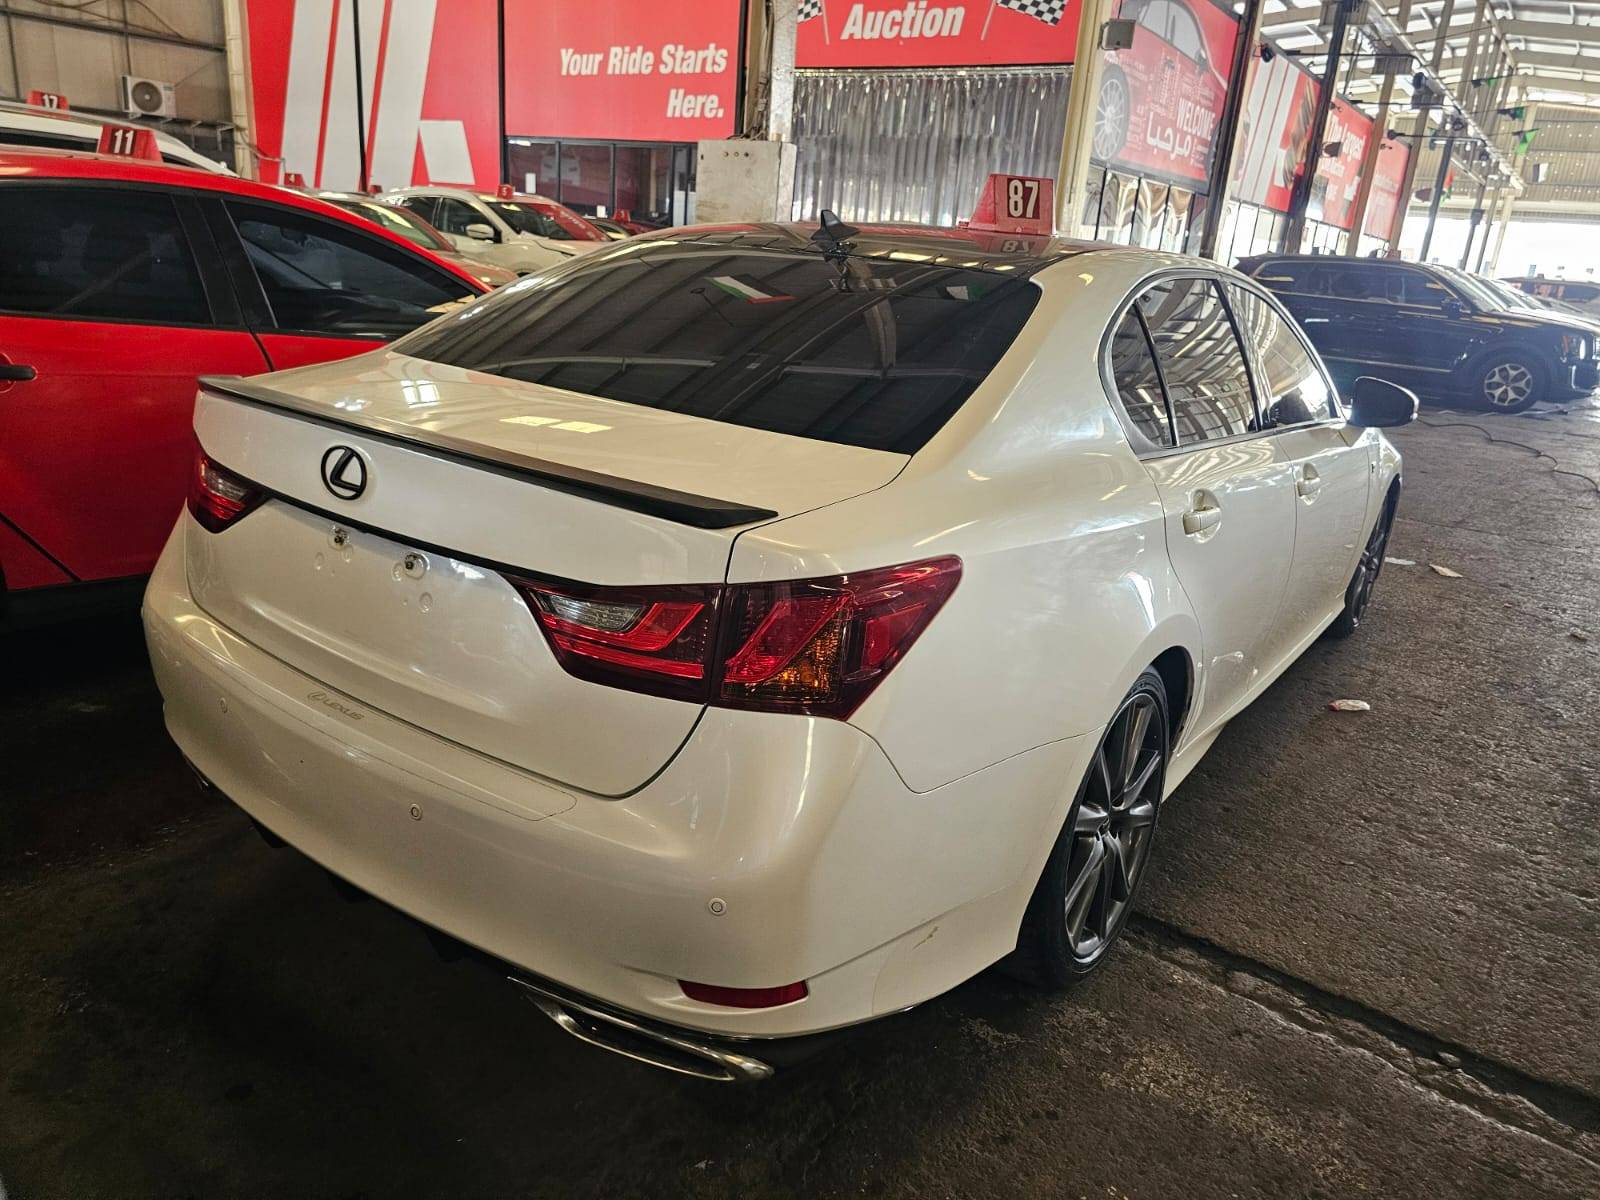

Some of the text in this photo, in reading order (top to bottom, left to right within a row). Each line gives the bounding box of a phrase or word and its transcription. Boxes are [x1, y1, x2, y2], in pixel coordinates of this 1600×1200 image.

[840, 1, 965, 40] Auction
[560, 43, 728, 76] Your Ride Starts
[666, 88, 724, 119] Here.
[1177, 96, 1216, 141] WELCOME
[113, 129, 135, 155] 11
[1146, 111, 1192, 160] مرحبا
[1008, 179, 1039, 218] 87
[321, 698, 365, 721] LEXUS
